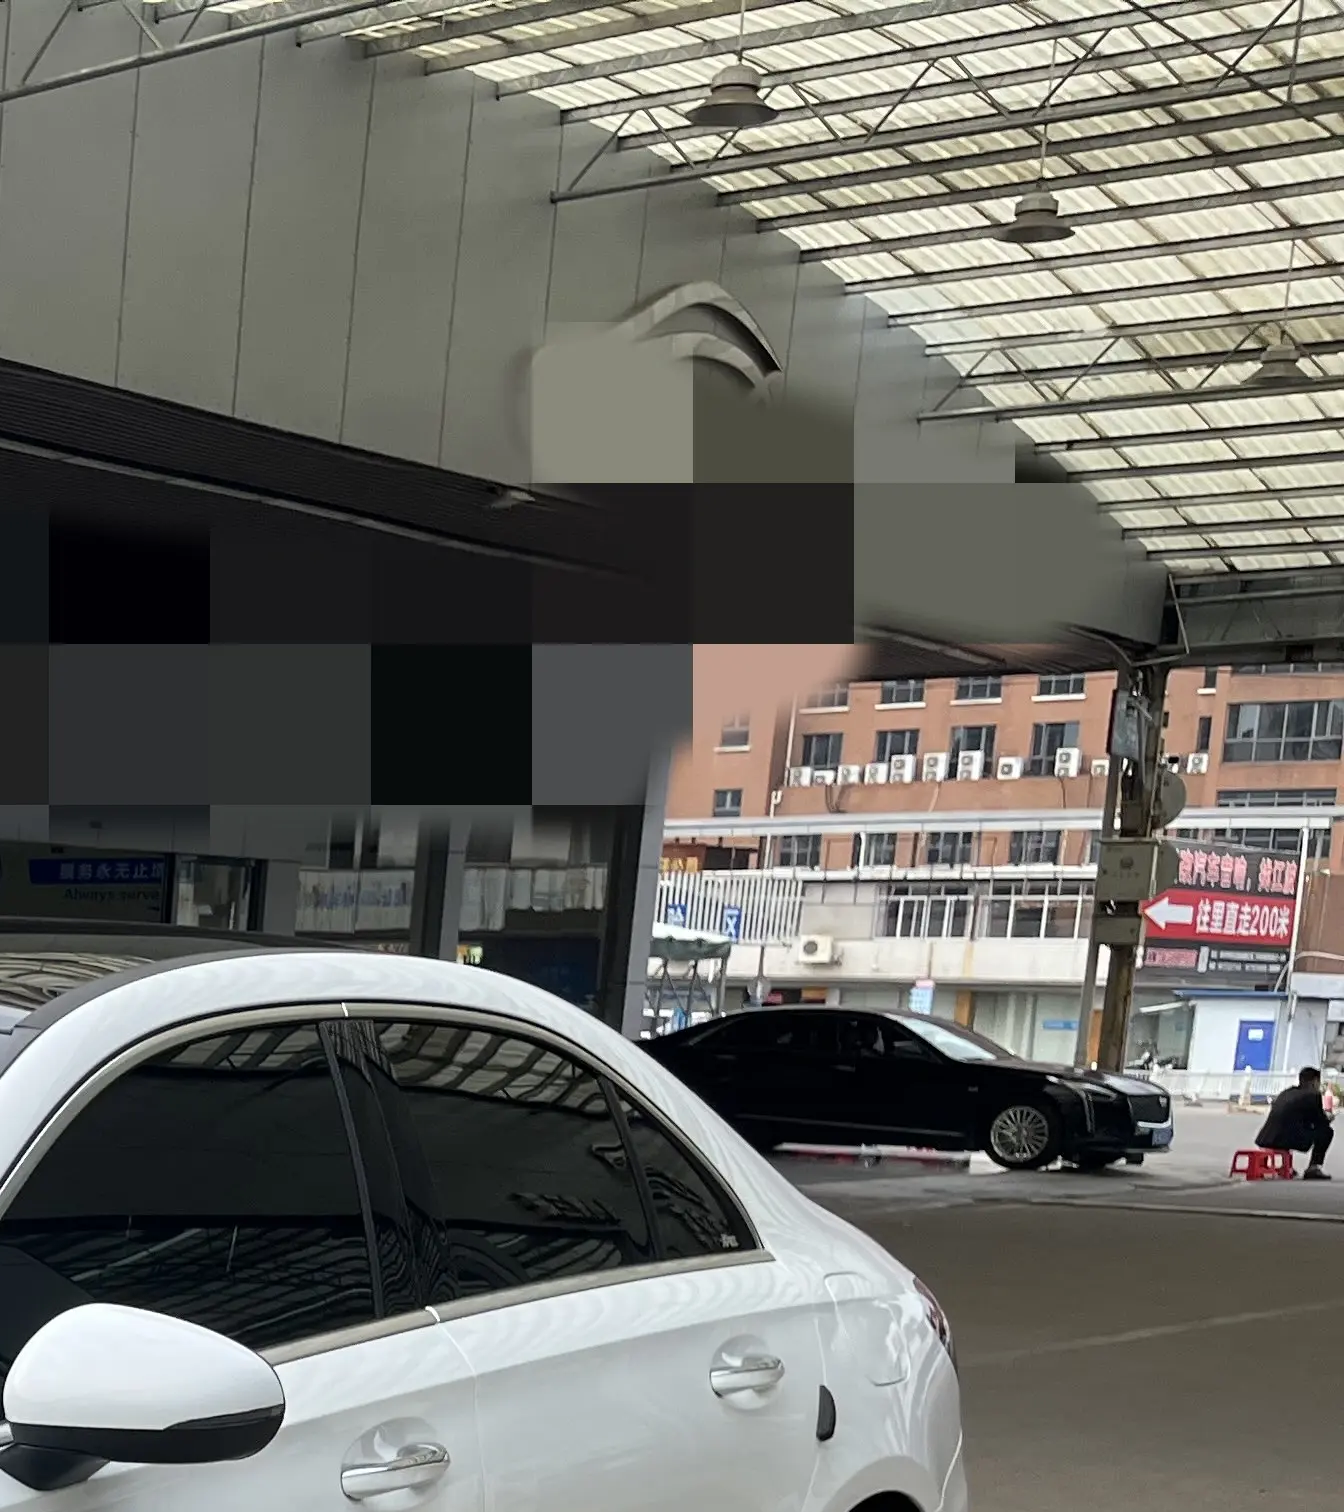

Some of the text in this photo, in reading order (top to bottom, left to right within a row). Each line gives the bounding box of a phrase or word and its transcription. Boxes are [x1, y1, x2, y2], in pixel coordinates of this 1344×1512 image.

[1195, 897, 1290, 939] 往里直走200米
